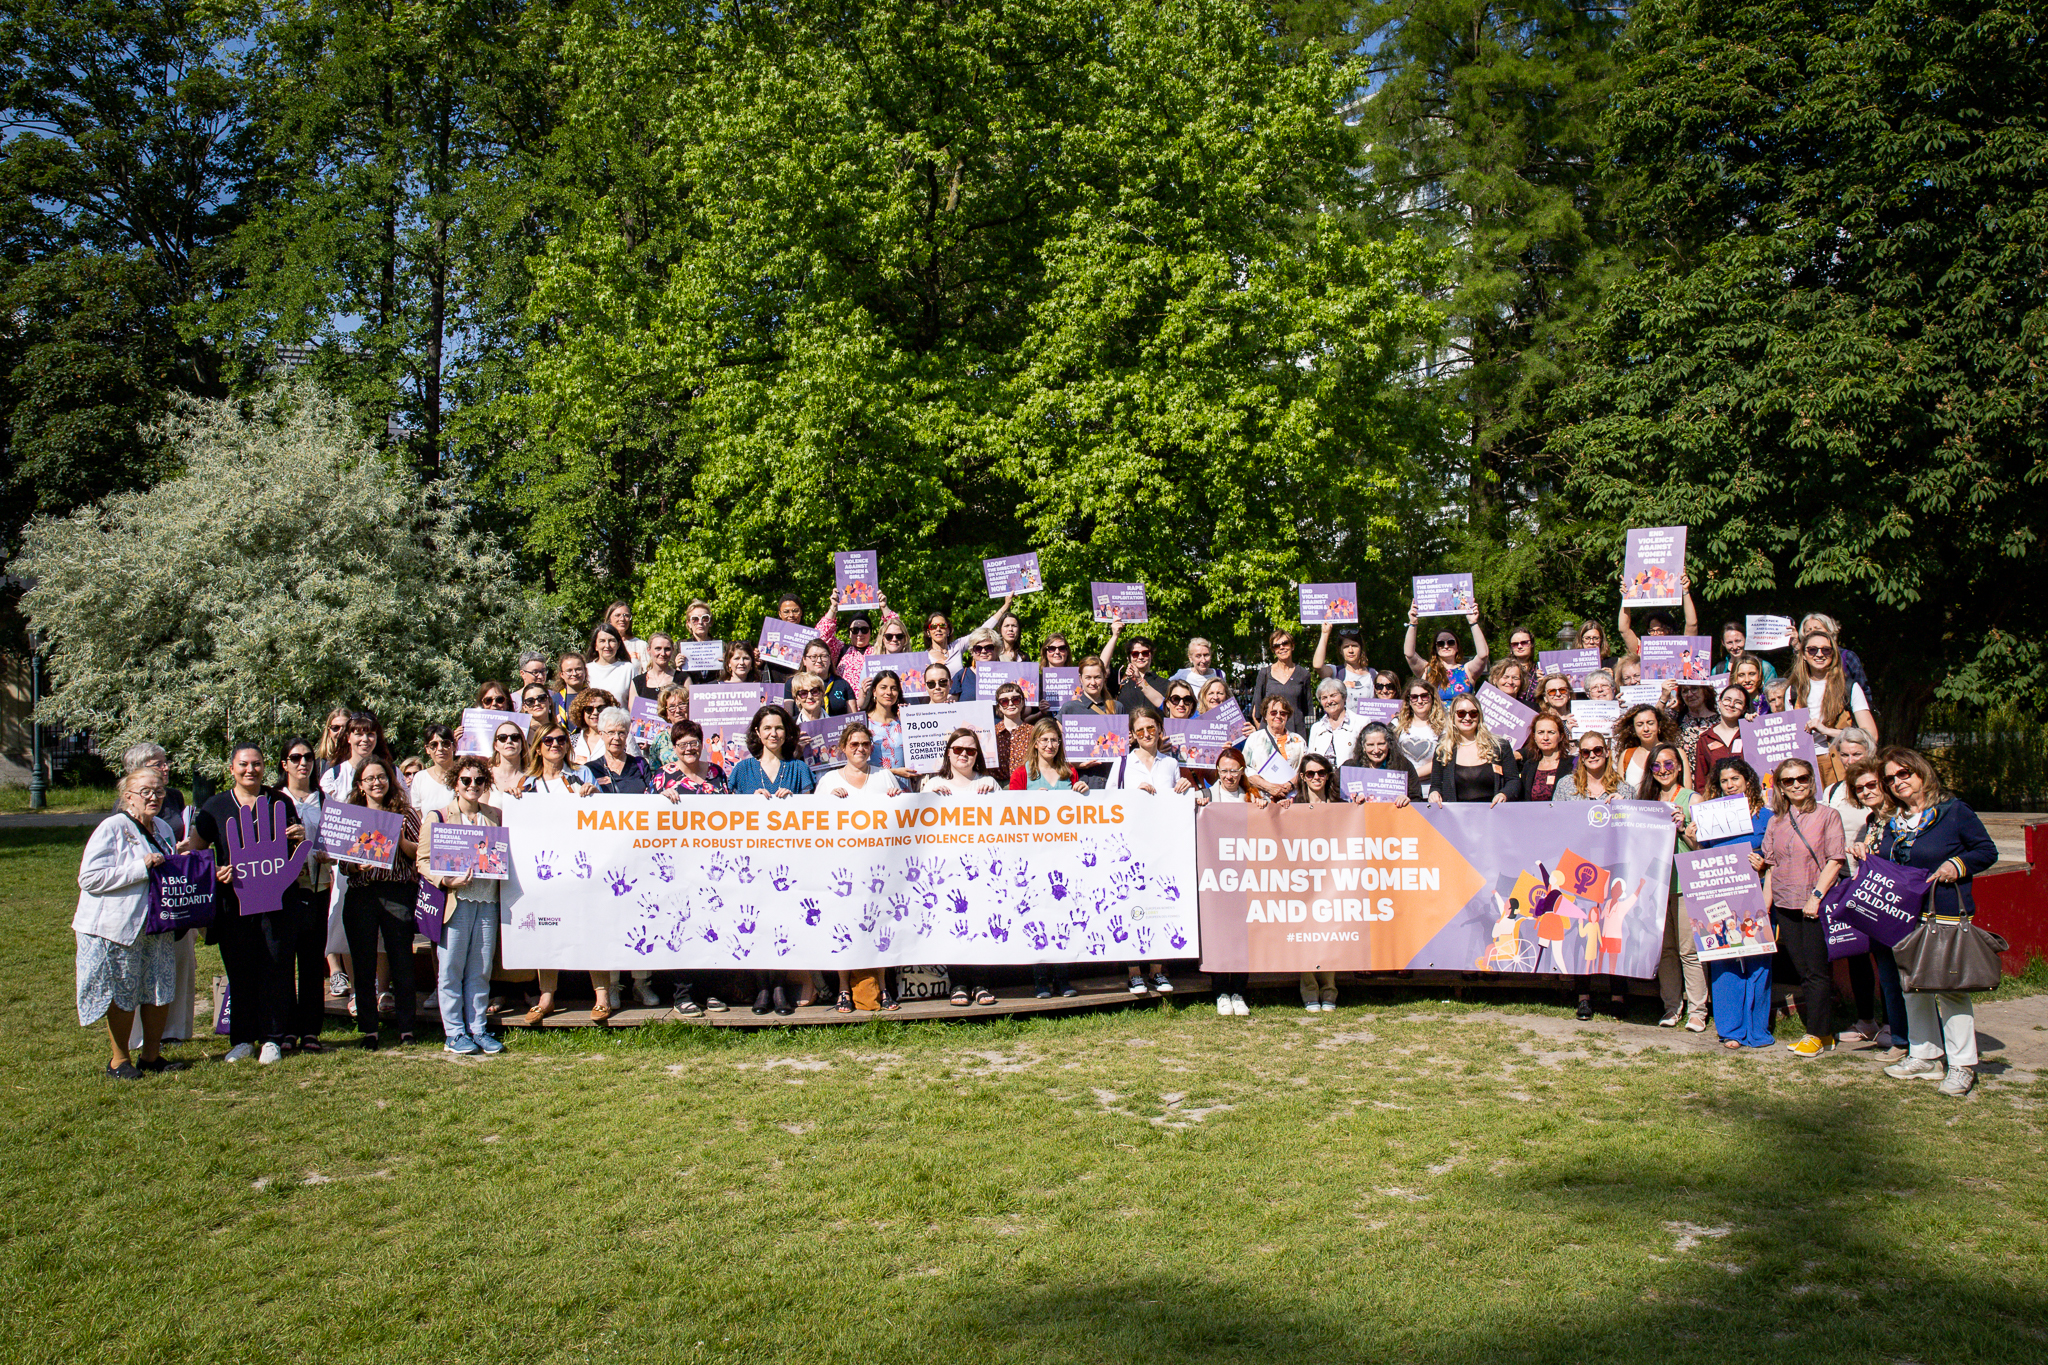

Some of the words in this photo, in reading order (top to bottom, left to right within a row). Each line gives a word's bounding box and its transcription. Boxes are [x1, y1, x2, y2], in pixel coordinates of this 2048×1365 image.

[1638, 536, 1674, 544] VIOLENCE
[986, 560, 1006, 568] ADOPT
[694, 691, 756, 700] PROSTITUTION
[1482, 688, 1513, 709] ADOPT
[1220, 700, 1235, 712] RAPE
[1479, 695, 1490, 706] THE
[1491, 703, 1526, 727] DIRECTIVE
[845, 715, 864, 723] RAPE
[1485, 707, 1517, 730] VIOLENCE
[1764, 716, 1783, 726] END
[907, 721, 938, 730] 78,000
[1753, 723, 1797, 737] VIOLENCE
[1757, 733, 1796, 746] AGAINST
[1757, 742, 1791, 755] WOMEN
[1766, 752, 1793, 762] GIRLS
[1367, 782, 1405, 790] EXPLOITATION
[325, 807, 342, 815] END
[577, 810, 649, 831] MAKE
[657, 810, 760, 831] EUROPE
[766, 810, 829, 831] SAFE
[837, 810, 888, 831] FOR
[894, 807, 993, 828] WOMEN
[1000, 806, 1050, 826] AND
[1056, 804, 1125, 825] GIRLS
[324, 814, 362, 827] VIOLENCE
[1697, 808, 1752, 838] RAPE
[320, 829, 350, 840] WOMEN
[321, 822, 357, 834] AGAINST
[434, 827, 483, 836] PROSTITUTION
[633, 838, 677, 849] ADOPT
[681, 838, 689, 848] A
[693, 838, 743, 849] ROBUST
[746, 838, 812, 849] DIRECTIVE
[815, 838, 834, 848] ON
[837, 836, 912, 848] COMBATING
[915, 833, 974, 844] VIOLENCE
[977, 833, 1029, 844] AGAINST
[1032, 832, 1078, 842] WOMEN
[1218, 838, 1278, 861] END
[1282, 837, 1419, 861] VIOLENCE
[236, 858, 285, 879] STOP
[1691, 856, 1724, 870] RAPE
[1725, 854, 1738, 864] IS
[1698, 867, 1736, 879] SEXUAL
[1867, 870, 1873, 878] A
[1873, 873, 1896, 889] BAG
[161, 877, 167, 885] A
[168, 876, 187, 885] BAG
[1198, 868, 1326, 892] AGAINST
[1331, 868, 1440, 891] WOMEN
[1690, 873, 1750, 889] EXPLOITATION
[162, 886, 185, 896] FULL
[186, 884, 197, 894] OF
[1860, 879, 1882, 898] FULL
[1885, 892, 1902, 905] OF
[161, 894, 213, 907] SOLIDARITY
[1853, 888, 1914, 923] SOLIDARITY
[1246, 900, 1307, 923] AND
[1312, 898, 1394, 922] GIRLS
[1286, 932, 1359, 943] #ENDVAWG
